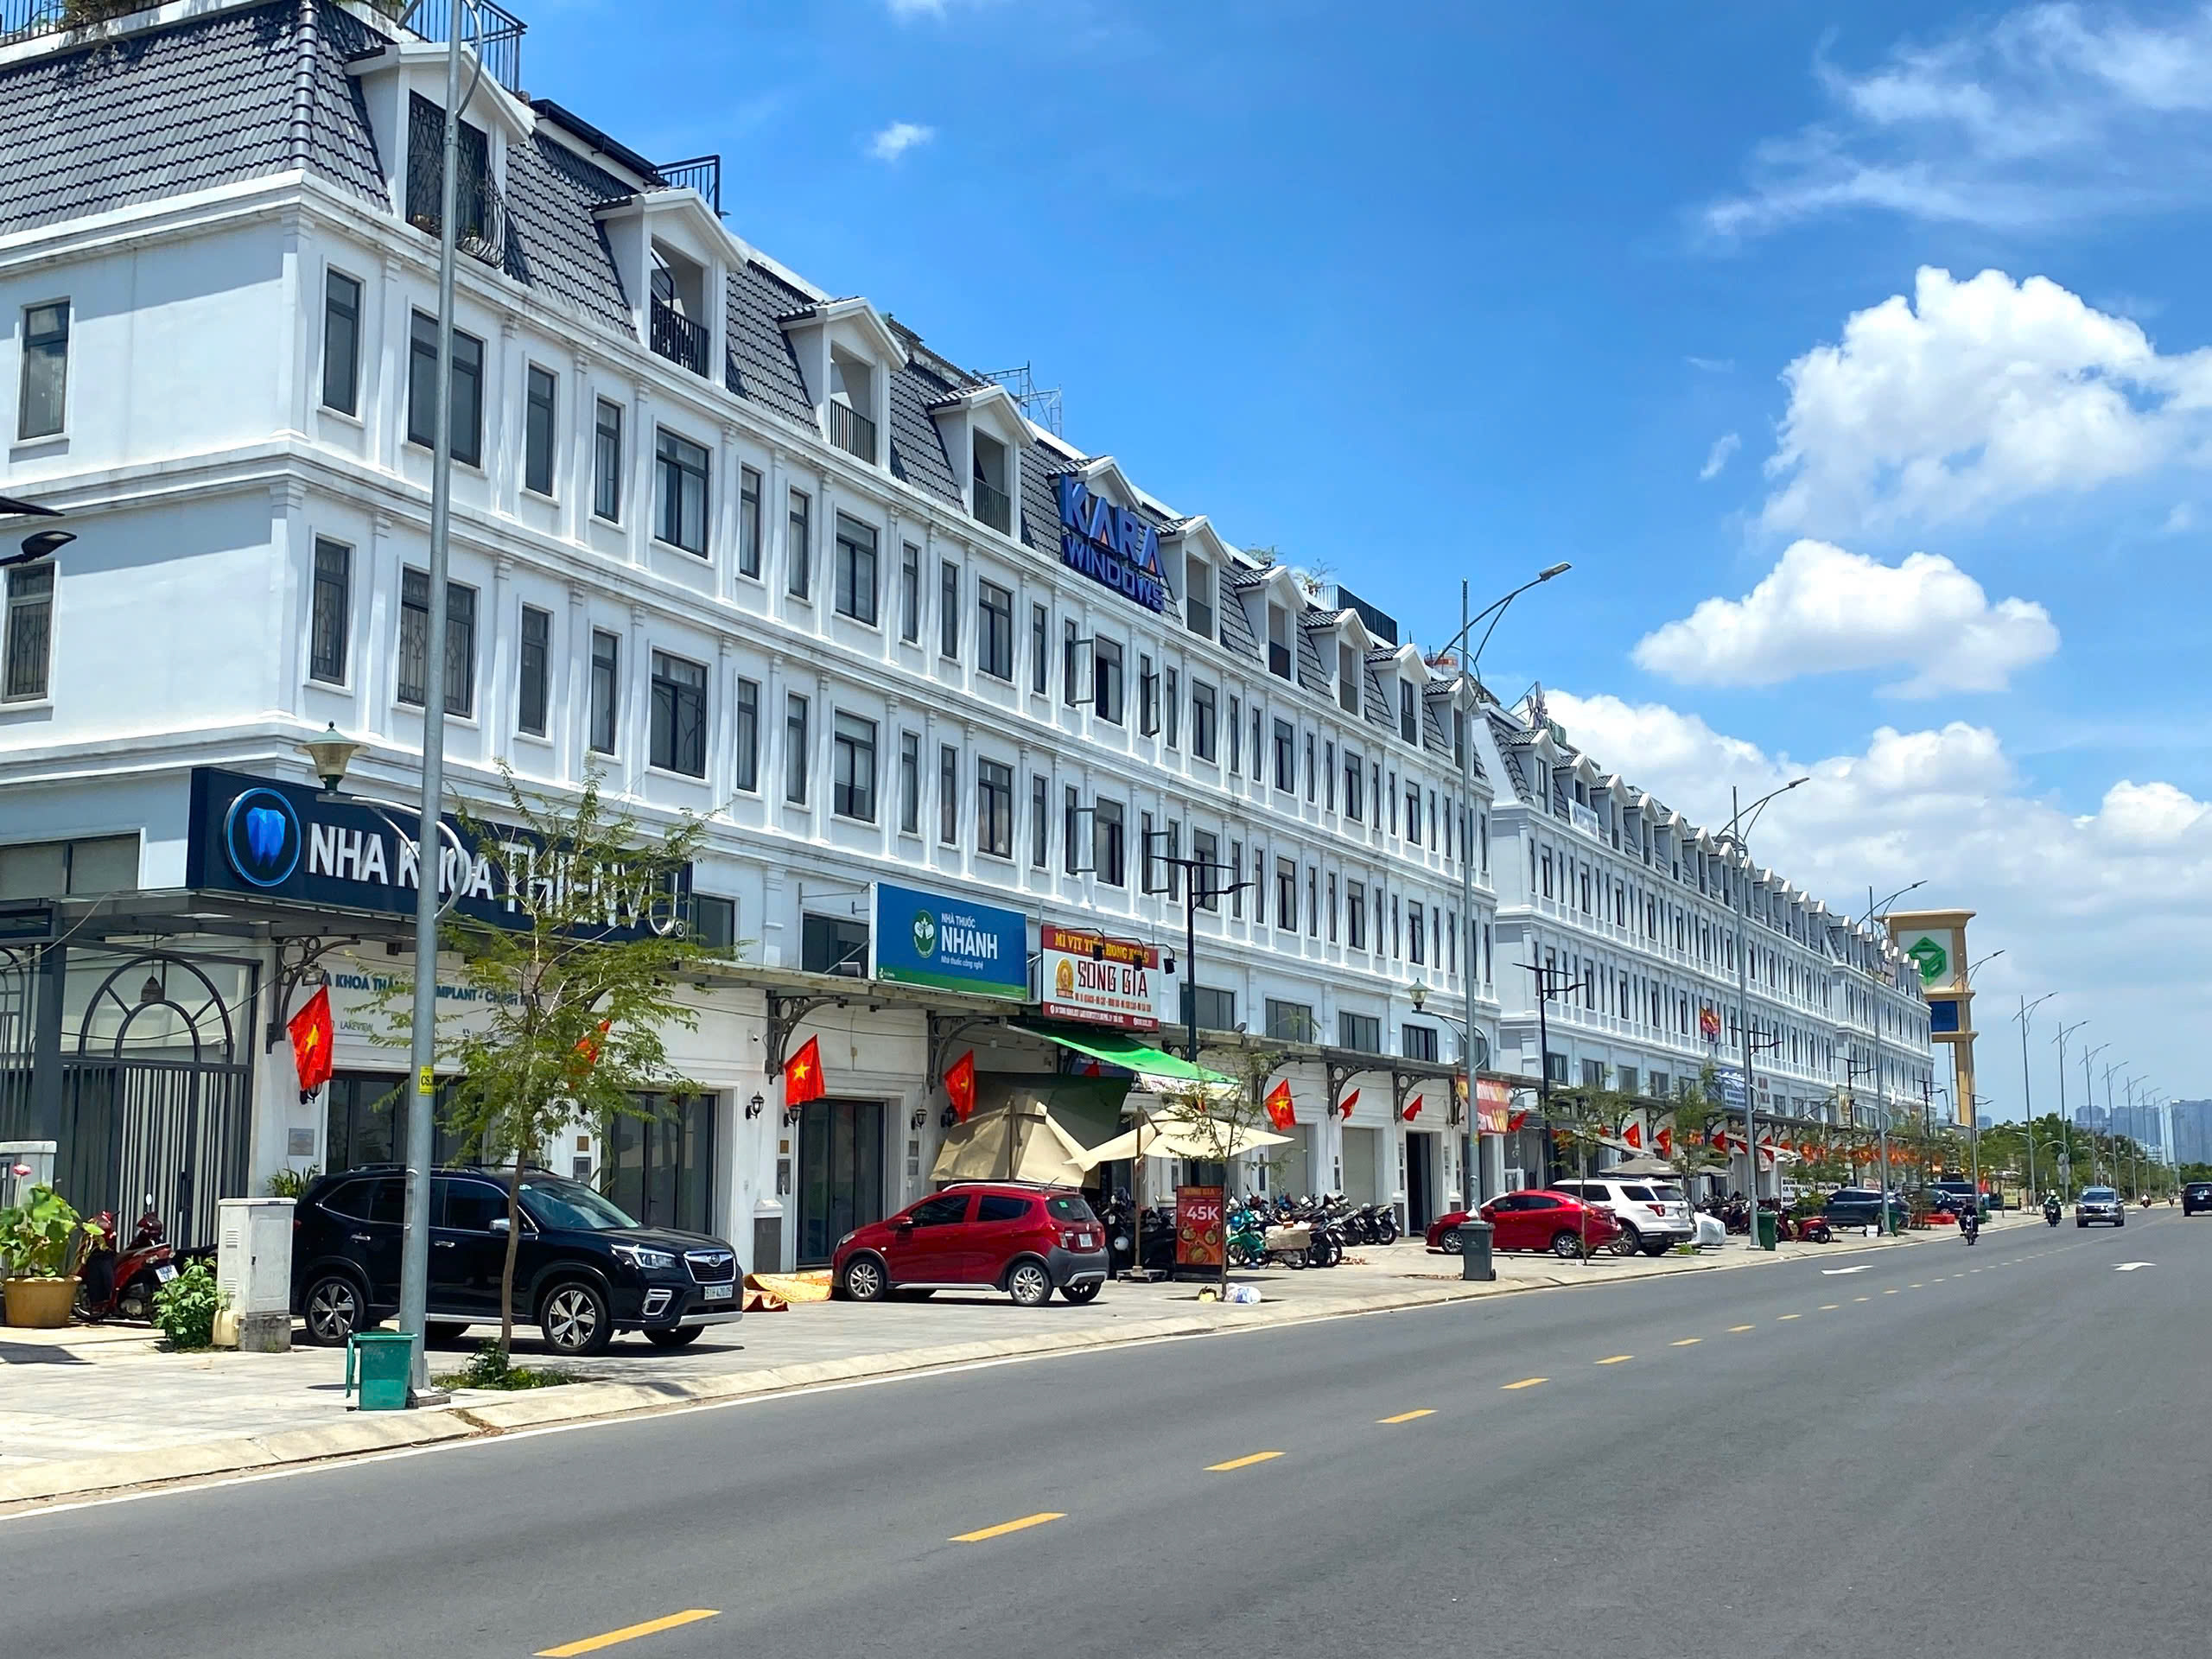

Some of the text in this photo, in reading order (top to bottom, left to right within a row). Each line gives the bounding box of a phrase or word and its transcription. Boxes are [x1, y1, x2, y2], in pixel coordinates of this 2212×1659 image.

[1060, 475, 1163, 577] KARA
[1062, 534, 1166, 613] WINDOWS
[307, 822, 389, 886] NHA
[941, 912, 956, 925] NHÀ
[941, 925, 998, 960] NHANH
[335, 974, 370, 991] KHOA
[435, 985, 477, 1001] MPLANT
[1077, 960, 1147, 998] SONG GIA
[1186, 1205, 1219, 1220] 45K
